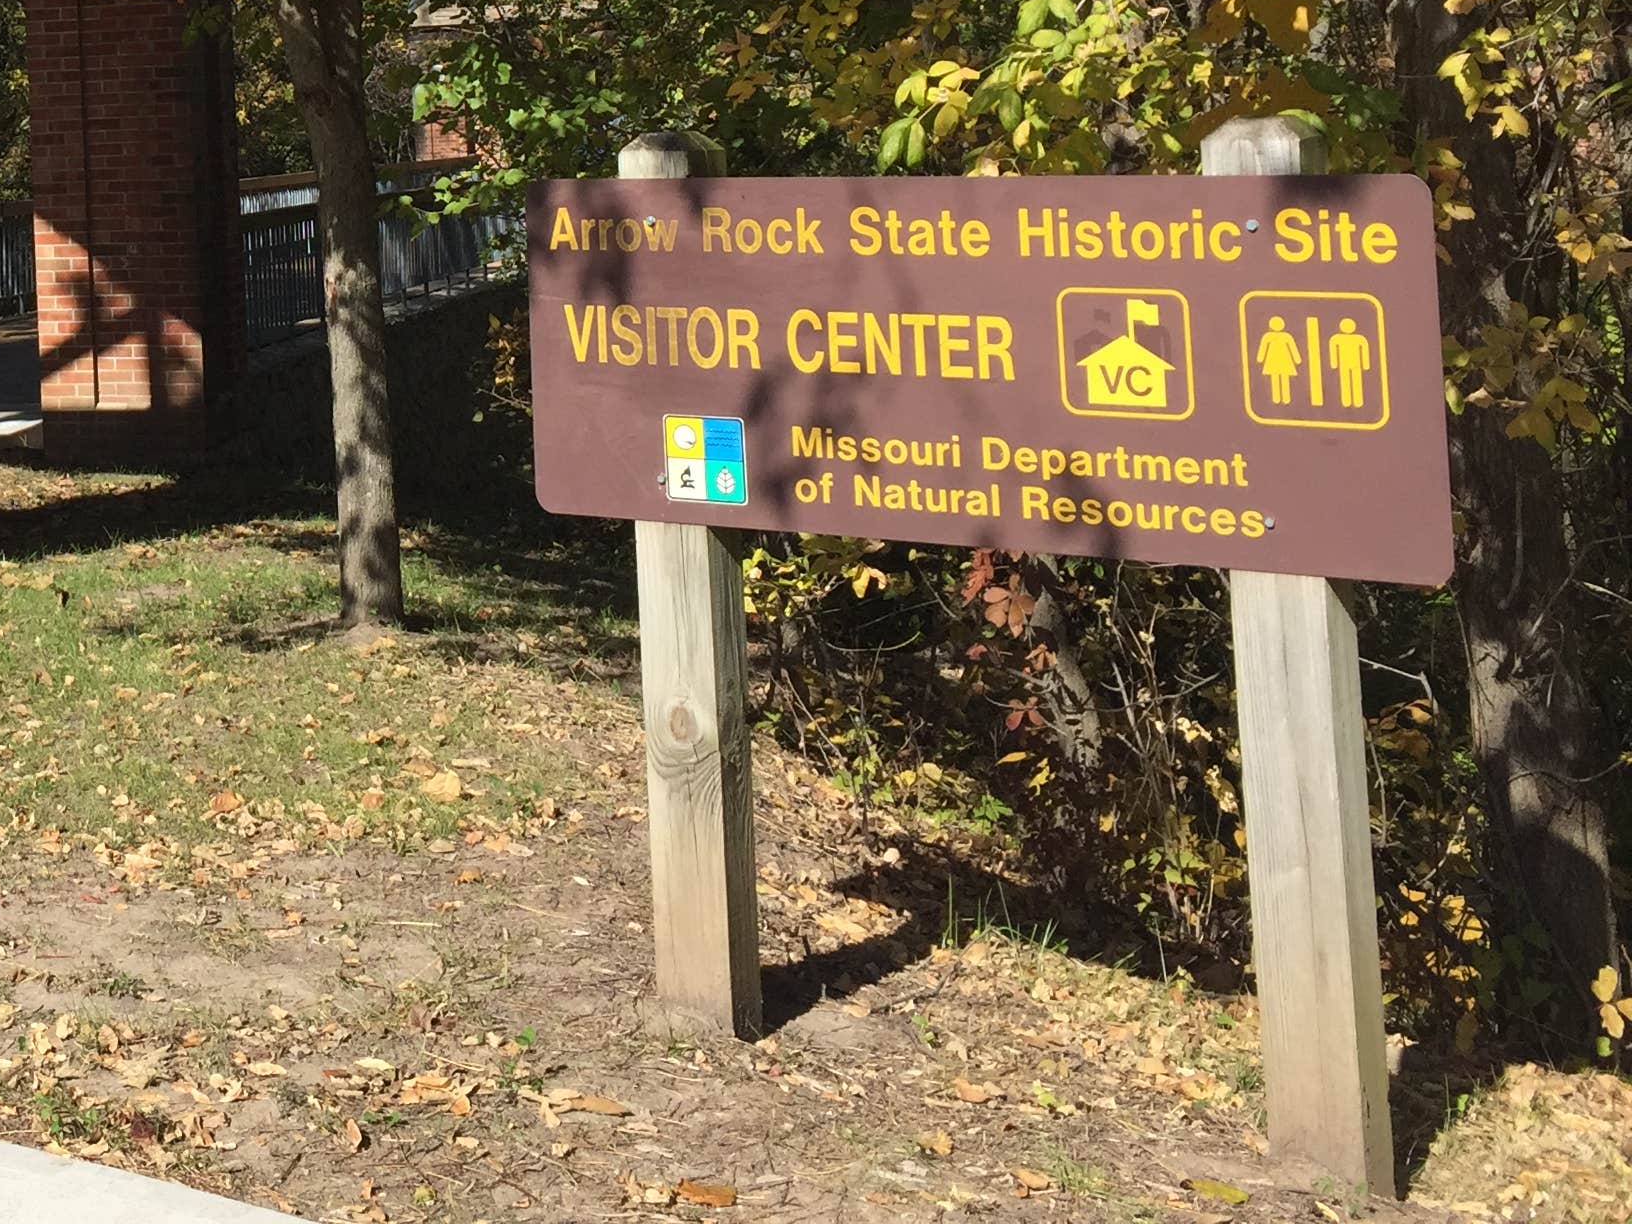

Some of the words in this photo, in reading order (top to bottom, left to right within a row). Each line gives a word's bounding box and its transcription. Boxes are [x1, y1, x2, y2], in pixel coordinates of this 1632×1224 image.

[549, 207, 678, 253] Arrow
[702, 206, 823, 255] Rock
[848, 207, 991, 258] State
[1018, 208, 1243, 262] Historic
[1273, 207, 1399, 265] Site
[564, 303, 761, 370] VISITOR
[785, 307, 1016, 382] CENTER
[1099, 363, 1153, 399] VC
[790, 424, 963, 469] Missouri
[982, 437, 1249, 488] Department
[794, 472, 835, 505] of
[853, 473, 1002, 518] Natural
[1021, 486, 1266, 539] Resources
